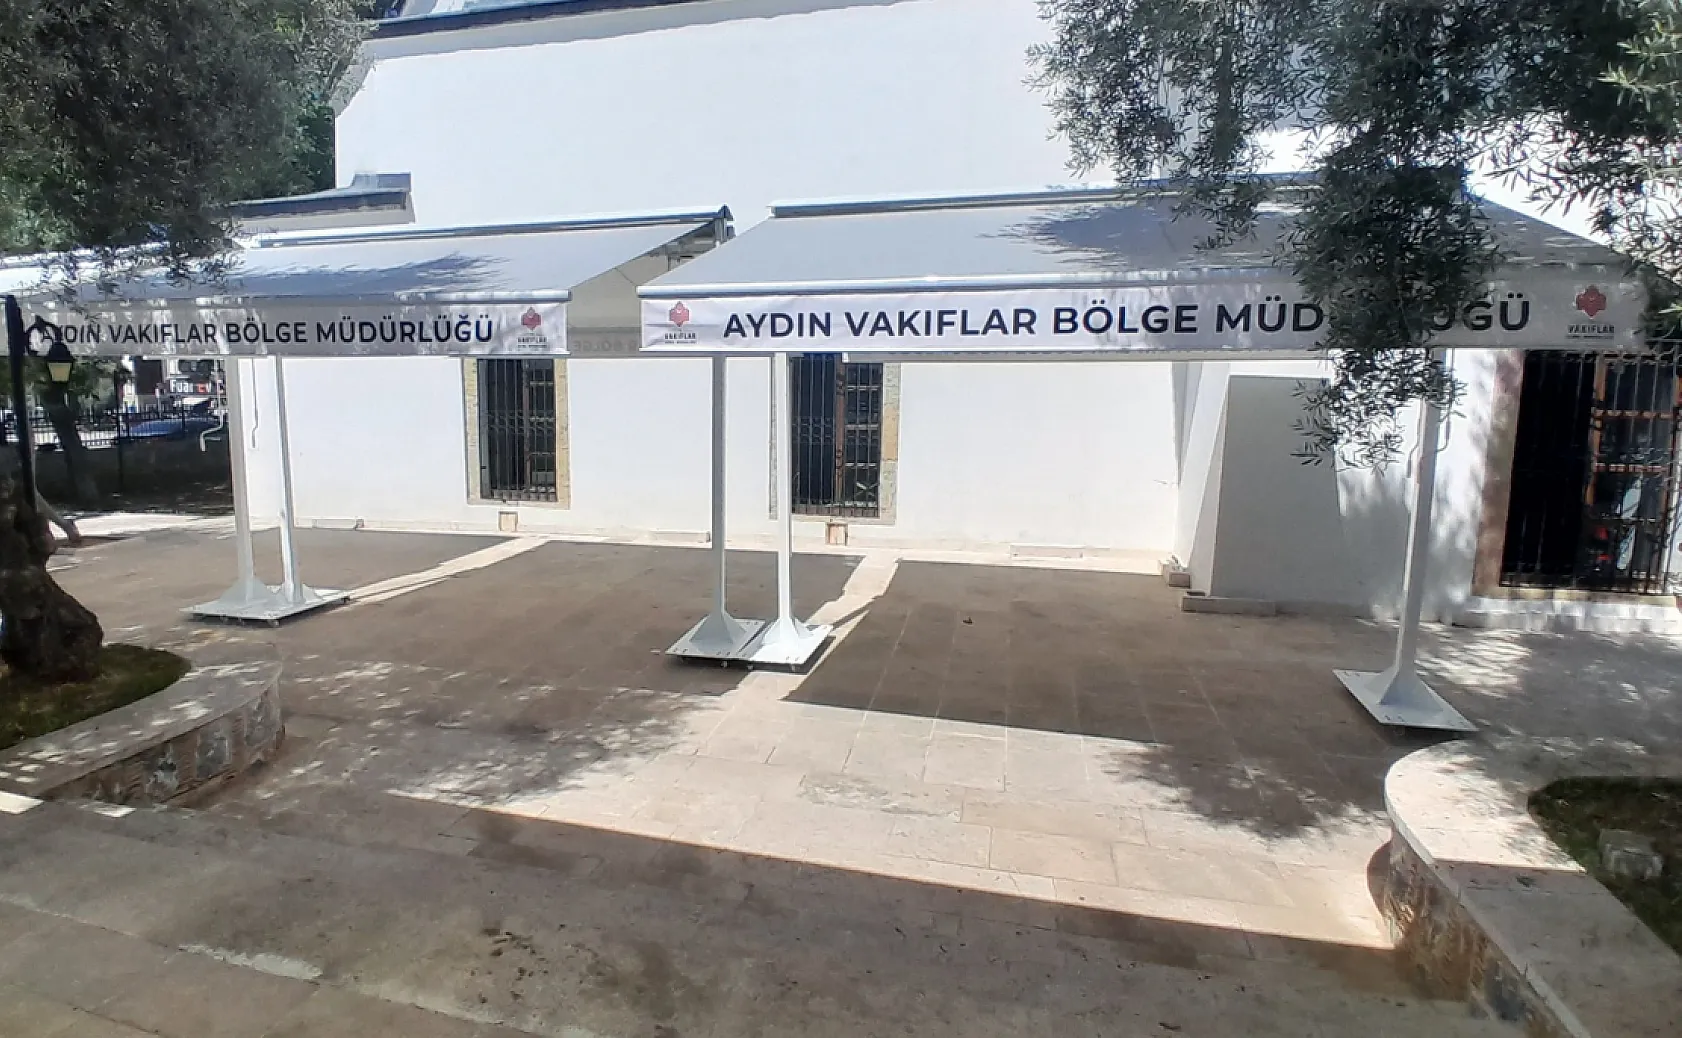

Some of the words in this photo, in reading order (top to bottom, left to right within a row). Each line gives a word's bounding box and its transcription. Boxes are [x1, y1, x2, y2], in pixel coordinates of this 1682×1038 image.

[108, 322, 218, 344] VAKIFLAR
[226, 316, 308, 343] BÖLGE
[316, 314, 493, 343] MÜDÜRLÜĞÜ
[723, 311, 832, 339] AYDIN
[844, 307, 1038, 338] VAKIFLAR
[1053, 298, 1199, 334] BÖLGE
